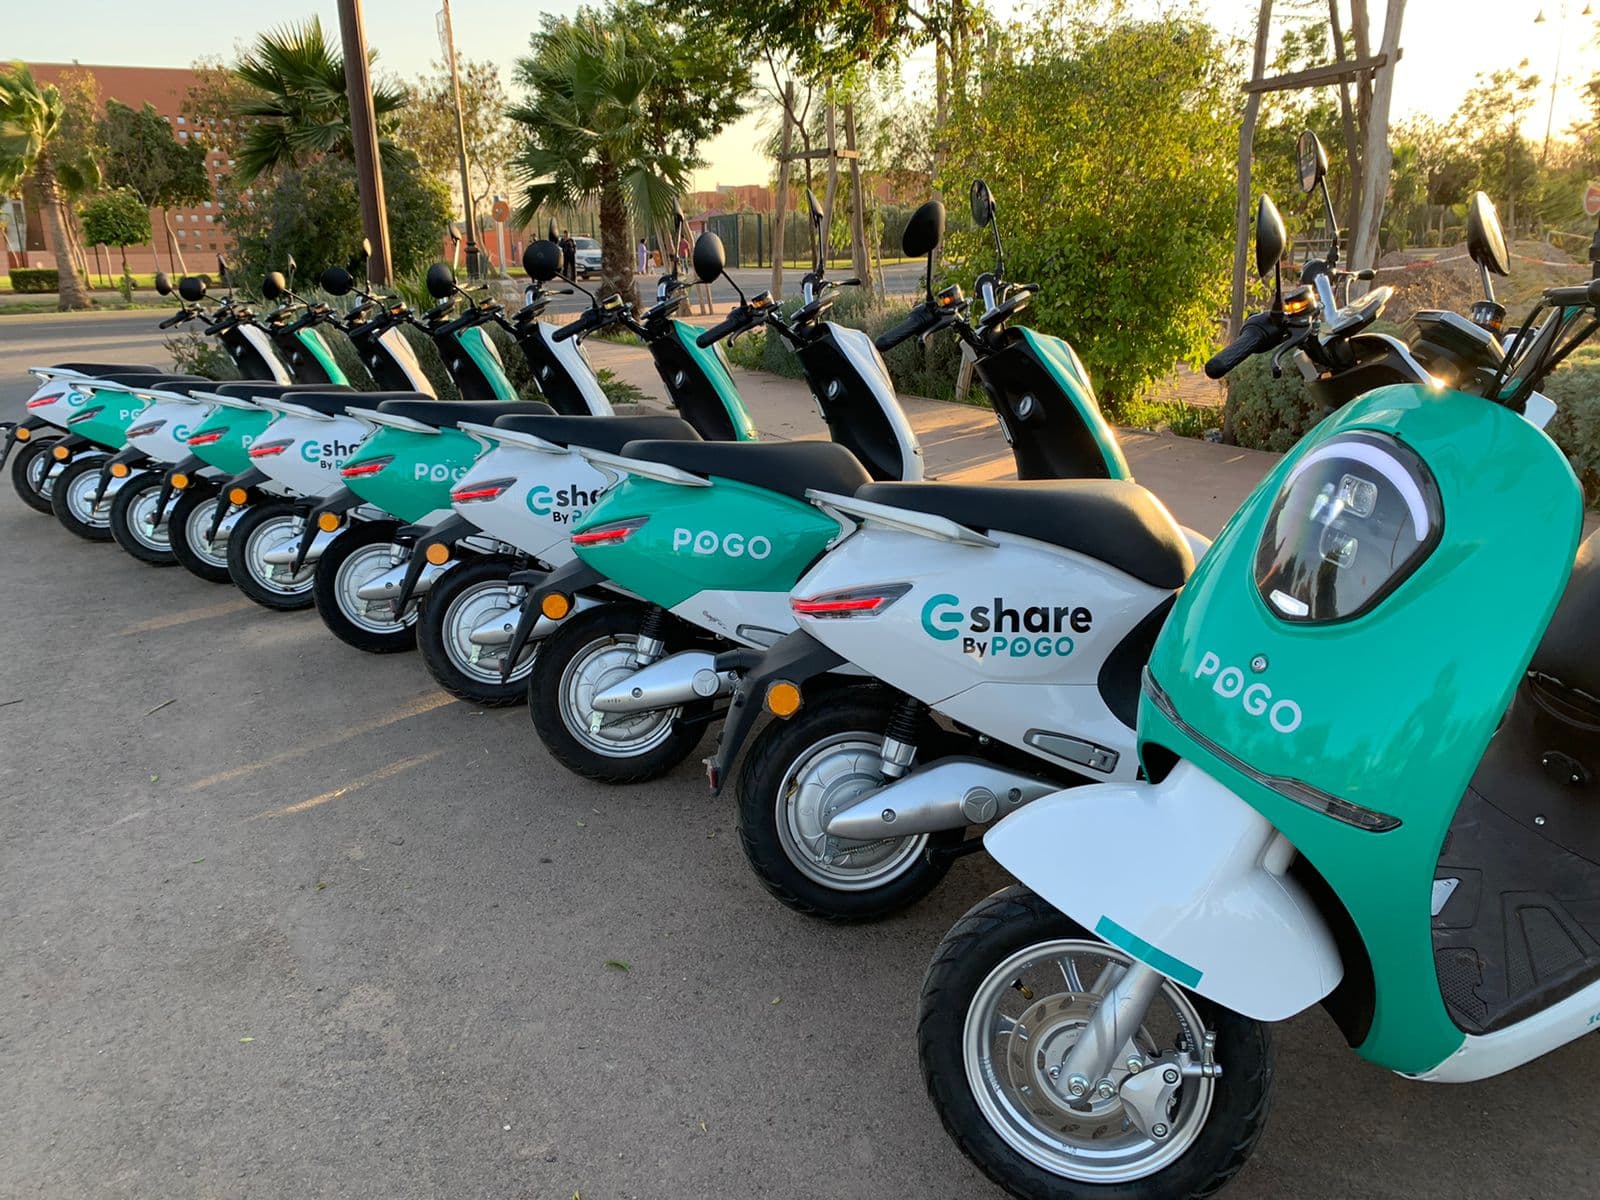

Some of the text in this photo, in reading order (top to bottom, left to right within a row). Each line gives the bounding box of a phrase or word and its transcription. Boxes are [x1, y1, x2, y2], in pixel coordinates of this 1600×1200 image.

[320, 460, 333, 471] By
[414, 462, 468, 482] POG
[553, 511, 569, 524] By
[673, 527, 772, 560] POGO
[963, 636, 1075, 658] By POGO
[1194, 650, 1303, 734] POGO
